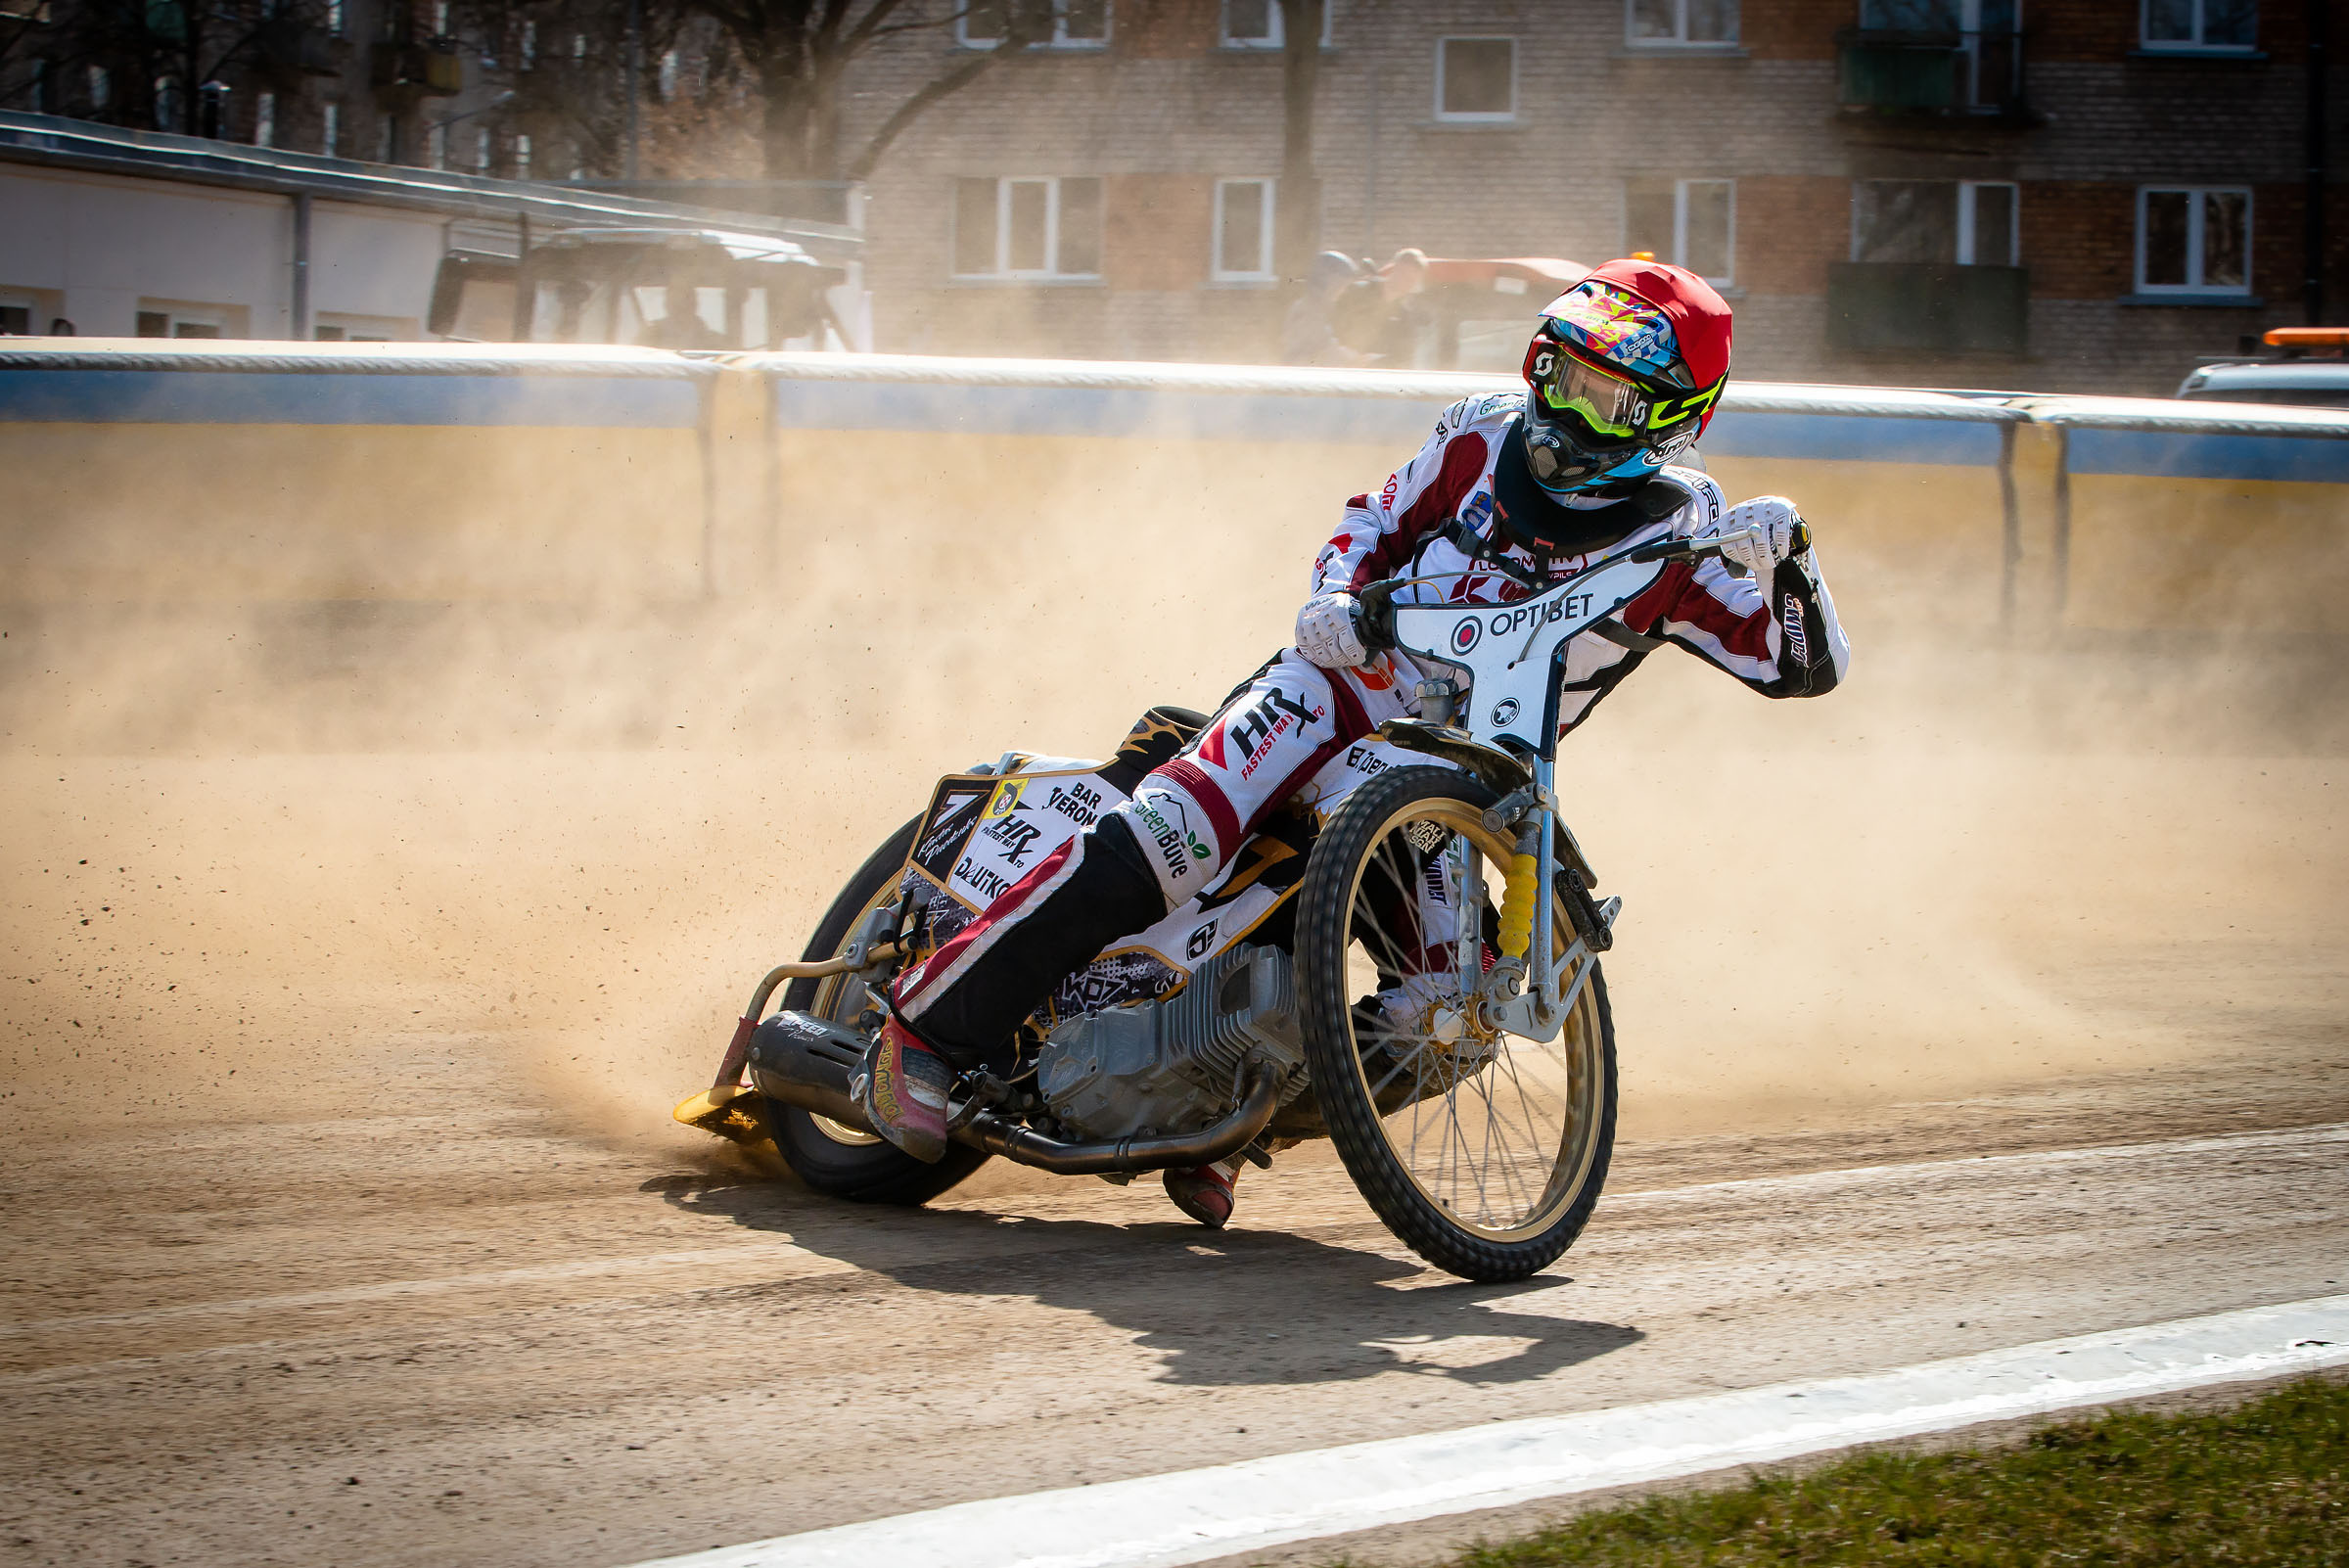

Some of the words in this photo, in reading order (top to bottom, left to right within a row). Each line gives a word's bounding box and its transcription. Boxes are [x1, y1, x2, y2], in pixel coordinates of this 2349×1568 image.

[1490, 593, 1594, 636] OPTIBET
[1241, 732, 1276, 781] FASTEST
[1273, 714, 1295, 736] WAY
[1313, 705, 1325, 718] TO
[1071, 781, 1102, 810] BAR
[981, 826, 1004, 843] FASTEST
[1001, 835, 1017, 849] WAY
[1013, 859, 1025, 869] TO
